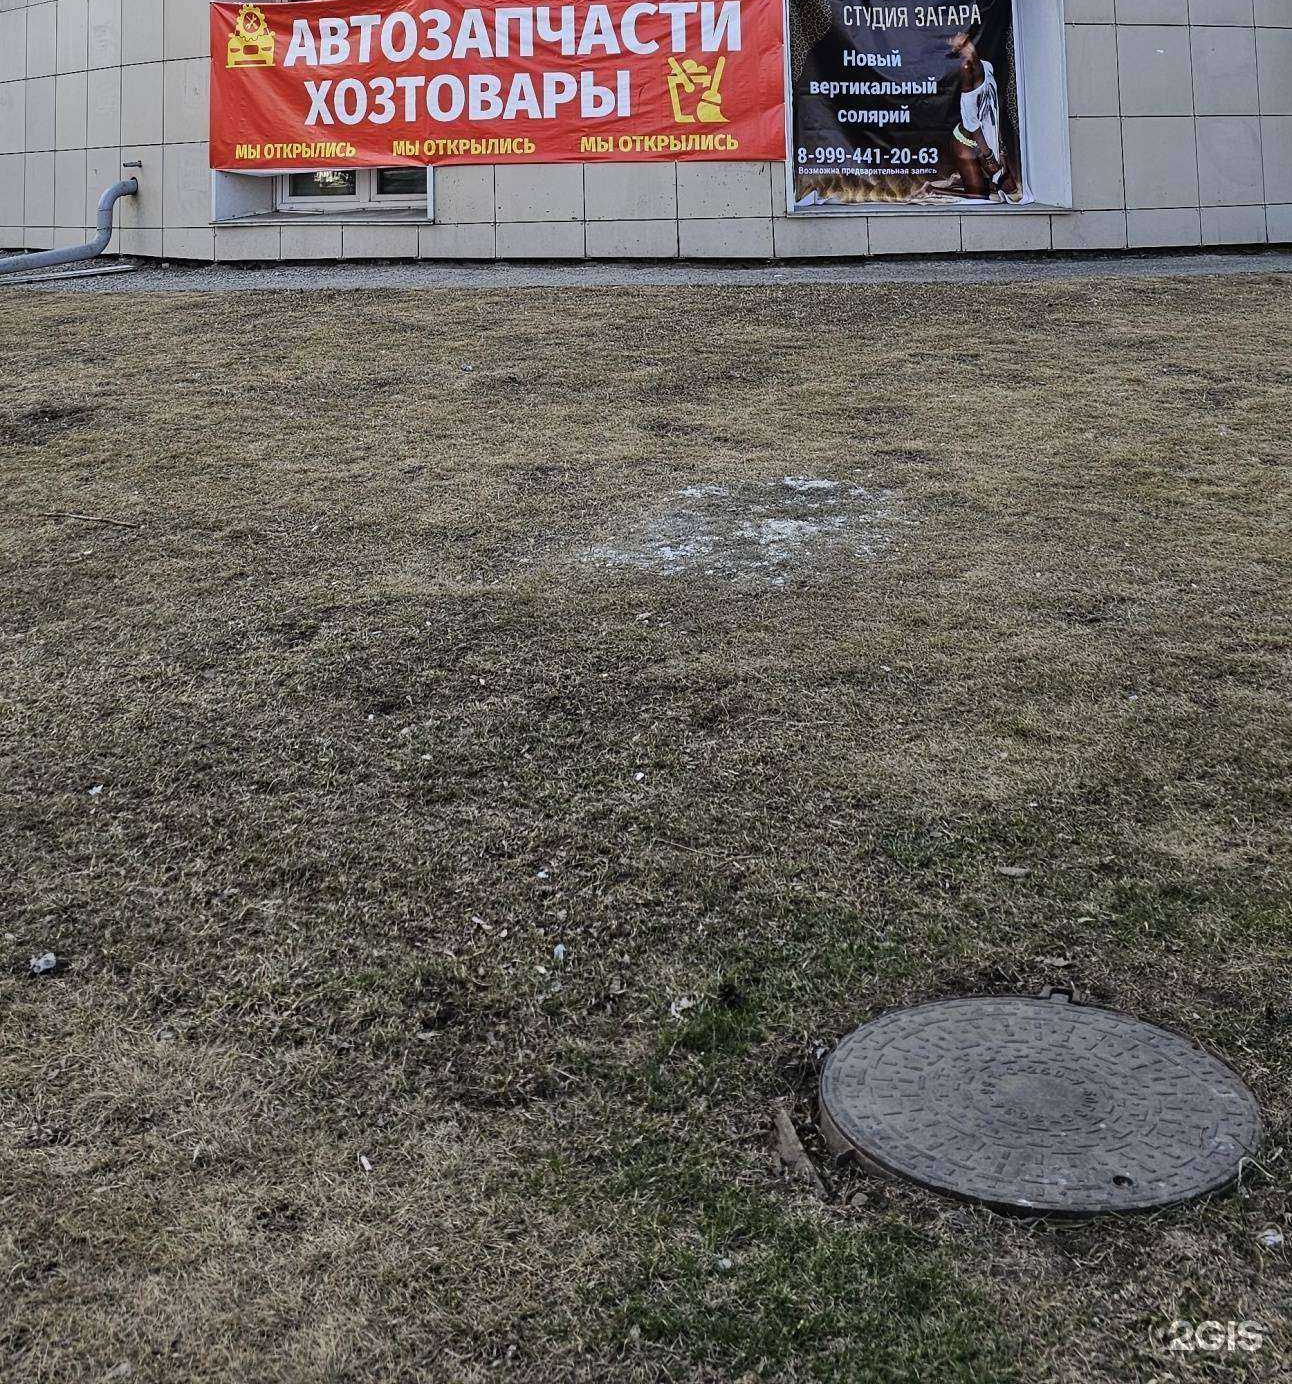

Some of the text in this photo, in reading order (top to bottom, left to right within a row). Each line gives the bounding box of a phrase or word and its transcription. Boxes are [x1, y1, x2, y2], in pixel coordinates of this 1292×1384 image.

[843, 3, 982, 30] СТУДИЯ ЗАГАРА
[283, 0, 742, 67] АВТОЗАПЧАСТИ
[843, 48, 902, 67] Новый
[304, 69, 631, 127] ХОЗТОВАРЫ
[809, 77, 938, 98] вертикальный
[837, 105, 910, 128] солярий
[235, 140, 356, 160] МЫ ОТКРЫЛИСЬ
[392, 137, 536, 157] МЫ ОТКРЫЛИСЬ
[580, 133, 739, 154] МЫ ОТКРЫЛИСЬ
[797, 147, 939, 165] 8-999-441-20-63
[798, 166, 938, 177] Возможна предварительная запись
